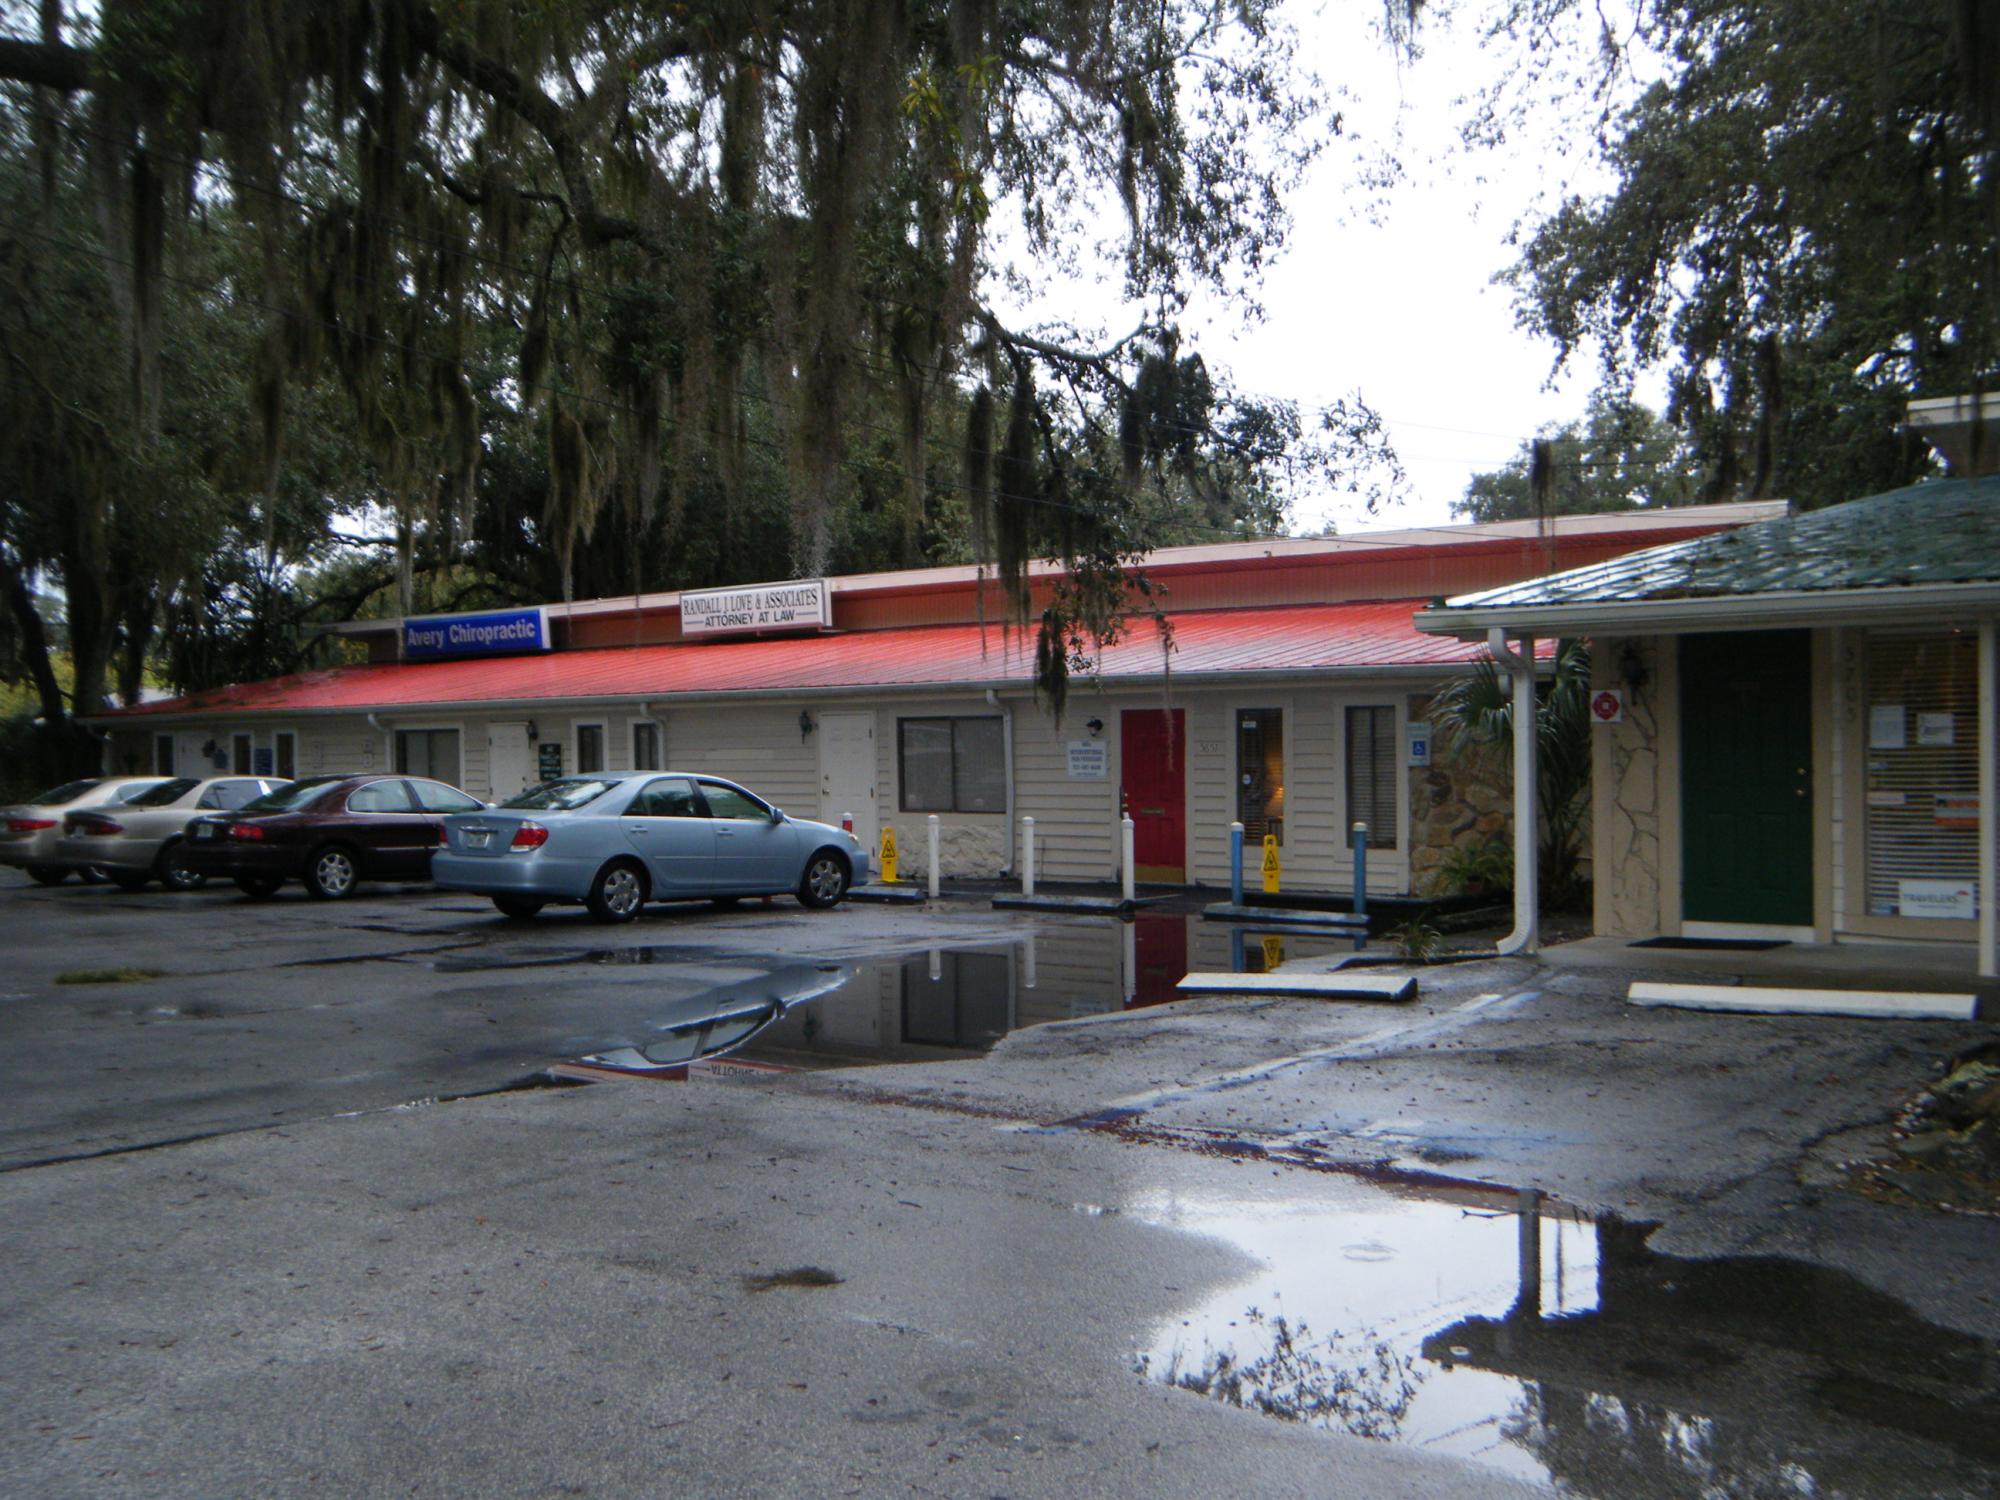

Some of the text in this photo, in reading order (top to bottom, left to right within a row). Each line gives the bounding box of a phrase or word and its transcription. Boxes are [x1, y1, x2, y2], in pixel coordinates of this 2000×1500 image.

[683, 597, 721, 615] RANDALL
[730, 593, 752, 612] LOVE
[754, 593, 761, 610] &
[764, 588, 818, 609] ASSOCIATES
[704, 609, 796, 628] ATTORNEY AT LAW
[407, 618, 536, 648] Avery Chiropractic
